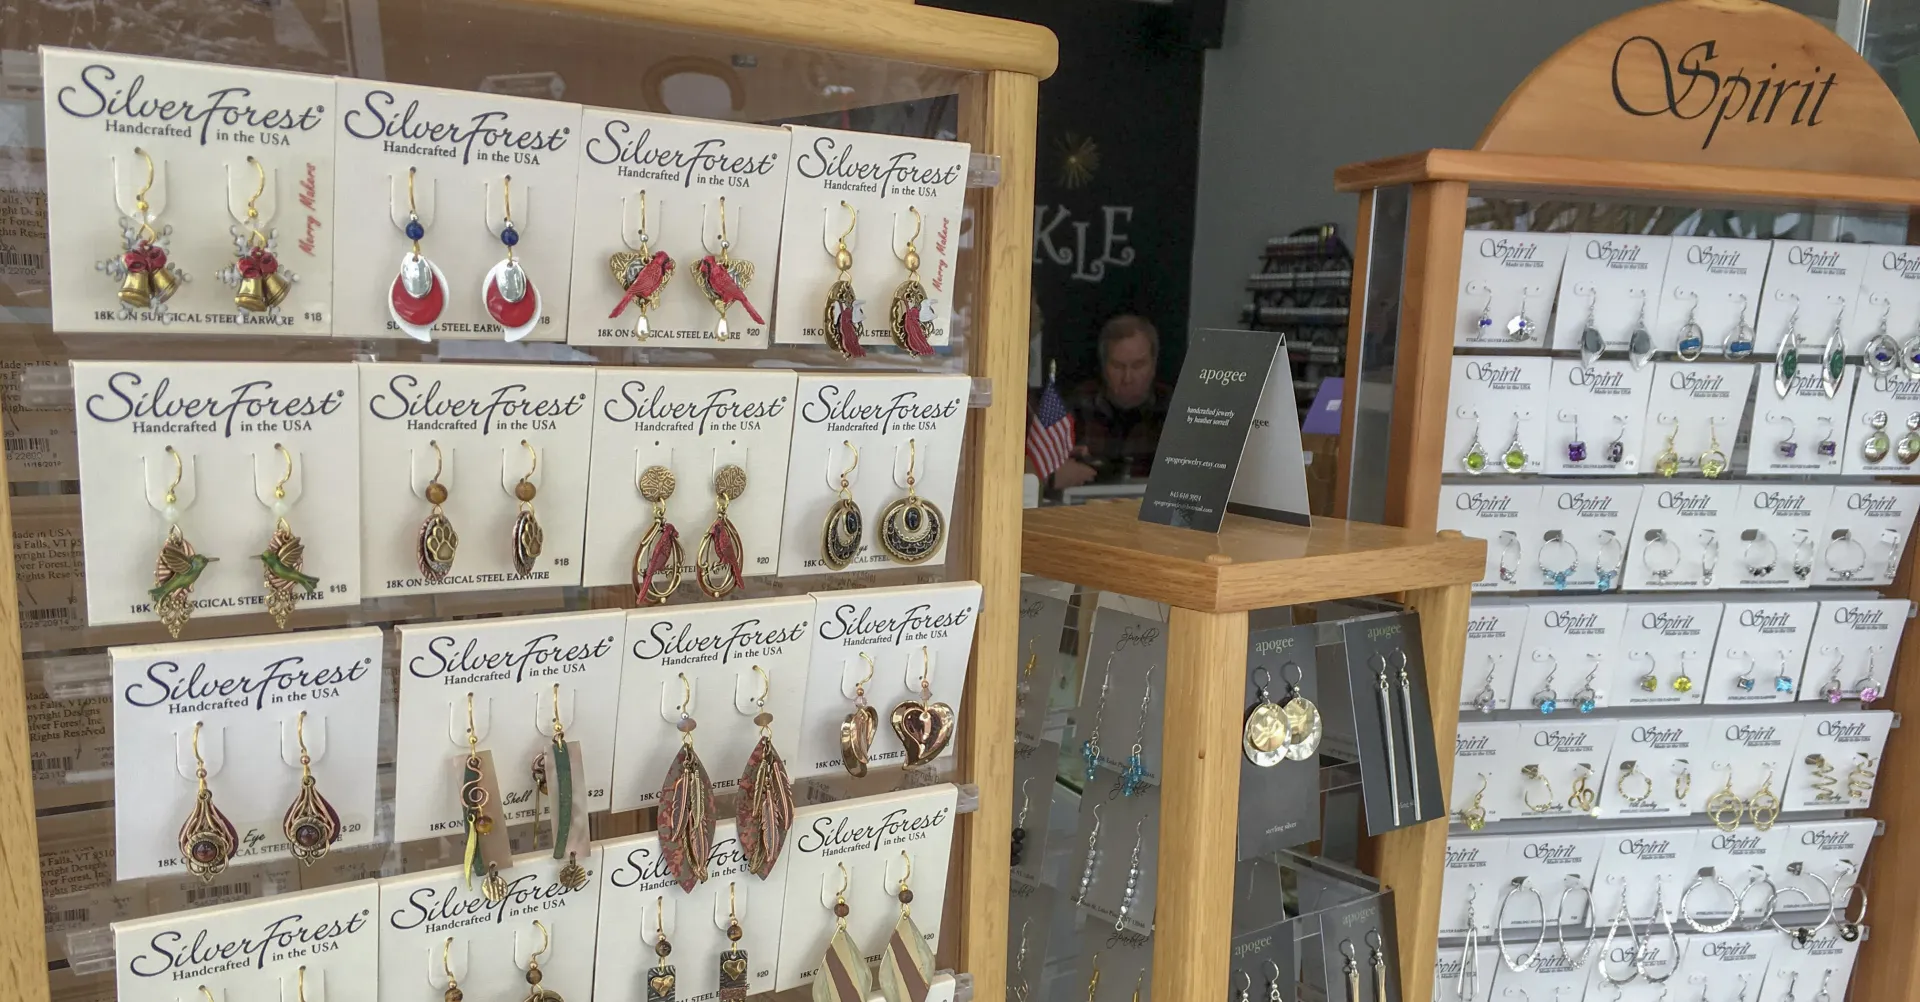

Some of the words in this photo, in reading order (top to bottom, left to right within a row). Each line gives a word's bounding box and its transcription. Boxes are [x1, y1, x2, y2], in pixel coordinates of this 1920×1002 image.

[1612, 36, 1838, 150] Spirit
[106, 120, 191, 137] Handcrafted
[216, 130, 229, 141] in
[234, 131, 254, 143] the
[260, 132, 290, 146] USA
[384, 141, 456, 158] Handcrafted
[477, 150, 488, 160] in
[492, 151, 510, 162] the
[514, 152, 540, 165] USA
[617, 165, 679, 182] Handcrafted
[697, 174, 706, 184] in
[709, 175, 725, 185] the
[728, 175, 750, 188] USA
[823, 180, 877, 194] Handcrafted
[891, 185, 899, 195] in
[901, 186, 916, 196] the
[918, 186, 937, 197] USA
[1480, 238, 1537, 265] Spirit
[1586, 240, 1641, 267] Spirit
[1687, 245, 1740, 272] Spirit
[1788, 246, 1840, 272] Spirit
[94, 311, 115, 321] 18K
[304, 311, 322, 322] $18
[437, 323, 471, 333] STEEL
[597, 329, 613, 339] 18K
[615, 329, 629, 339] ON
[676, 332, 702, 341] STEEL
[747, 328, 760, 338] $20
[1200, 368, 1247, 385] apogee
[1466, 361, 1521, 388] Spirit
[1569, 367, 1624, 392] Spirit
[1670, 371, 1723, 397] Spirit
[133, 421, 216, 433] Handcrafted
[241, 422, 252, 431] in
[257, 421, 277, 432] the
[283, 419, 312, 431] USA
[407, 420, 476, 430] Handcrafted
[497, 421, 507, 430] in
[511, 420, 528, 430] the
[532, 419, 556, 430] USA
[635, 422, 693, 431] Handcrafted
[710, 422, 719, 431] in
[722, 422, 737, 431] the
[740, 421, 761, 431] USA
[827, 422, 878, 432] Handcrafted
[892, 422, 900, 431] in
[903, 422, 916, 431] the
[918, 421, 936, 431] USA
[1456, 492, 1511, 516] Spirit
[1558, 492, 1612, 516] Spirit
[1658, 491, 1711, 516] Spirit
[1754, 491, 1805, 515] Spirit
[1847, 492, 1897, 516] Spirit
[554, 558, 569, 566] $18
[757, 556, 769, 564] $20
[330, 585, 346, 594] $18
[386, 580, 404, 588] 18K
[406, 578, 422, 587] ON
[476, 574, 504, 583] STEEL
[130, 604, 150, 613] 18K
[1834, 607, 1883, 629] Spirit
[1544, 610, 1597, 633] Spirit
[1740, 609, 1790, 633] Spirit
[843, 634, 892, 646] Handcrafted
[905, 632, 913, 641] in
[930, 629, 948, 639] USA
[1367, 623, 1401, 644] apogee
[1255, 636, 1294, 655] apogee
[661, 652, 718, 666] Handcrafted
[734, 650, 742, 659] in
[745, 649, 760, 659] the
[763, 647, 782, 656] USA
[444, 670, 510, 685] Handcrafted
[529, 668, 539, 676] in
[543, 666, 559, 676] the
[563, 664, 586, 674] USA
[168, 697, 249, 714] Handcrafted
[272, 694, 283, 704] in
[287, 691, 307, 702] the
[311, 688, 339, 700] USA
[1534, 730, 1587, 754] Spirit
[1725, 725, 1775, 746] Spirit
[1817, 721, 1866, 742] Spirit
[503, 790, 533, 806] Shell
[588, 789, 604, 797] $23
[342, 824, 361, 833] $20
[430, 822, 446, 831] 18K
[449, 820, 464, 829] ON
[822, 841, 871, 858] Handcrafted
[883, 837, 891, 845] in
[893, 835, 906, 844] the
[908, 831, 926, 842] USA
[1619, 839, 1670, 860] Spirit
[1711, 834, 1761, 855] Spirit
[1801, 830, 1849, 850] Spirit
[1524, 843, 1576, 864] Spirit
[711, 870, 719, 878] in
[722, 868, 736, 877] the
[425, 913, 491, 934] Handcrafted
[509, 908, 520, 918] in
[523, 904, 538, 915] the
[543, 898, 566, 911] USA
[1342, 905, 1376, 927] apogee
[1235, 935, 1272, 958] apogee
[172, 958, 251, 981] Handcrafted
[272, 952, 284, 961] in
[287, 948, 306, 959] the
[311, 941, 339, 953] USA
